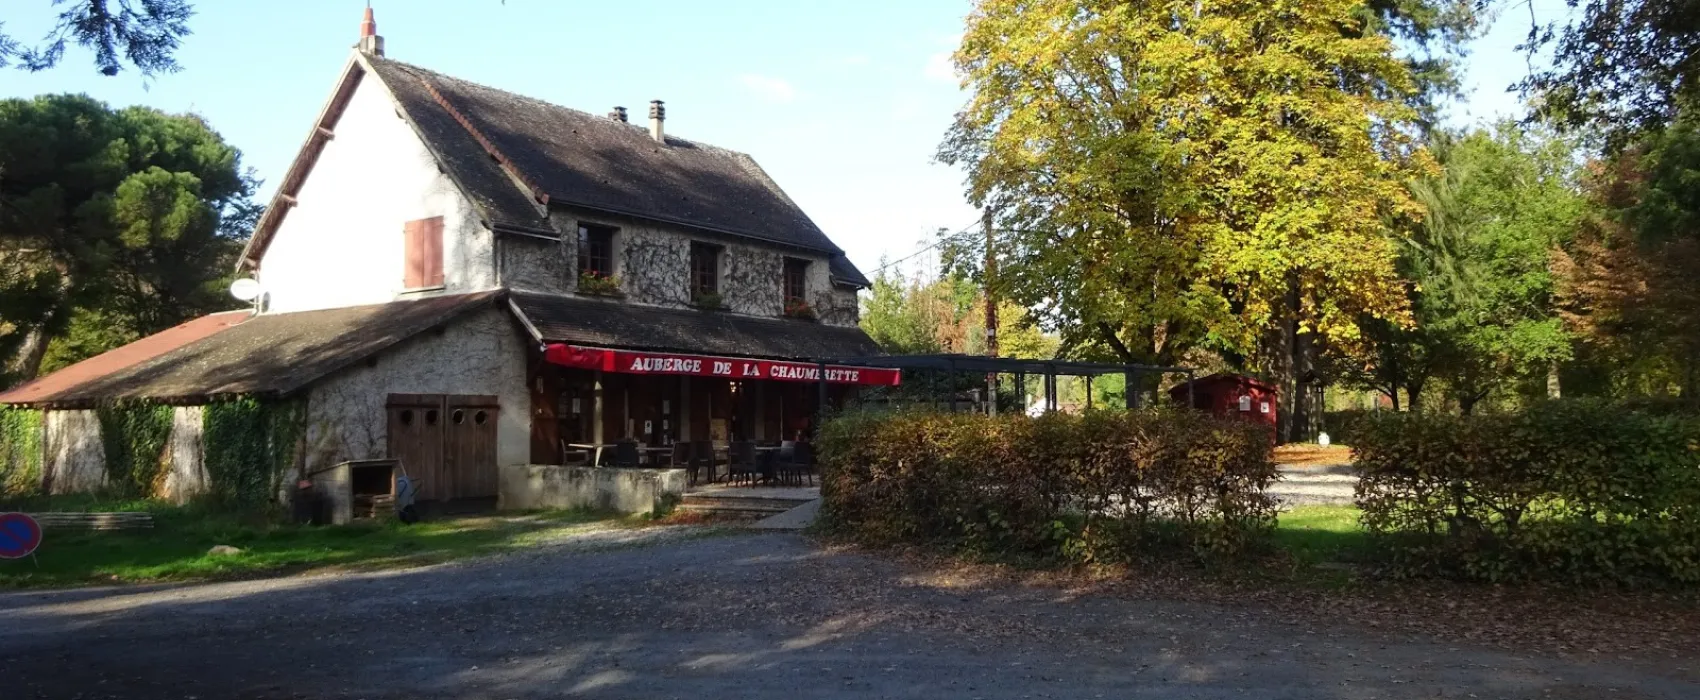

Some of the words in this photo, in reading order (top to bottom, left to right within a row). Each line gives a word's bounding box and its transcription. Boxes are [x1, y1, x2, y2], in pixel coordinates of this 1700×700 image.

[630, 357, 701, 373] AUBERGE
[713, 361, 732, 375] DE
[743, 363, 760, 376] LA
